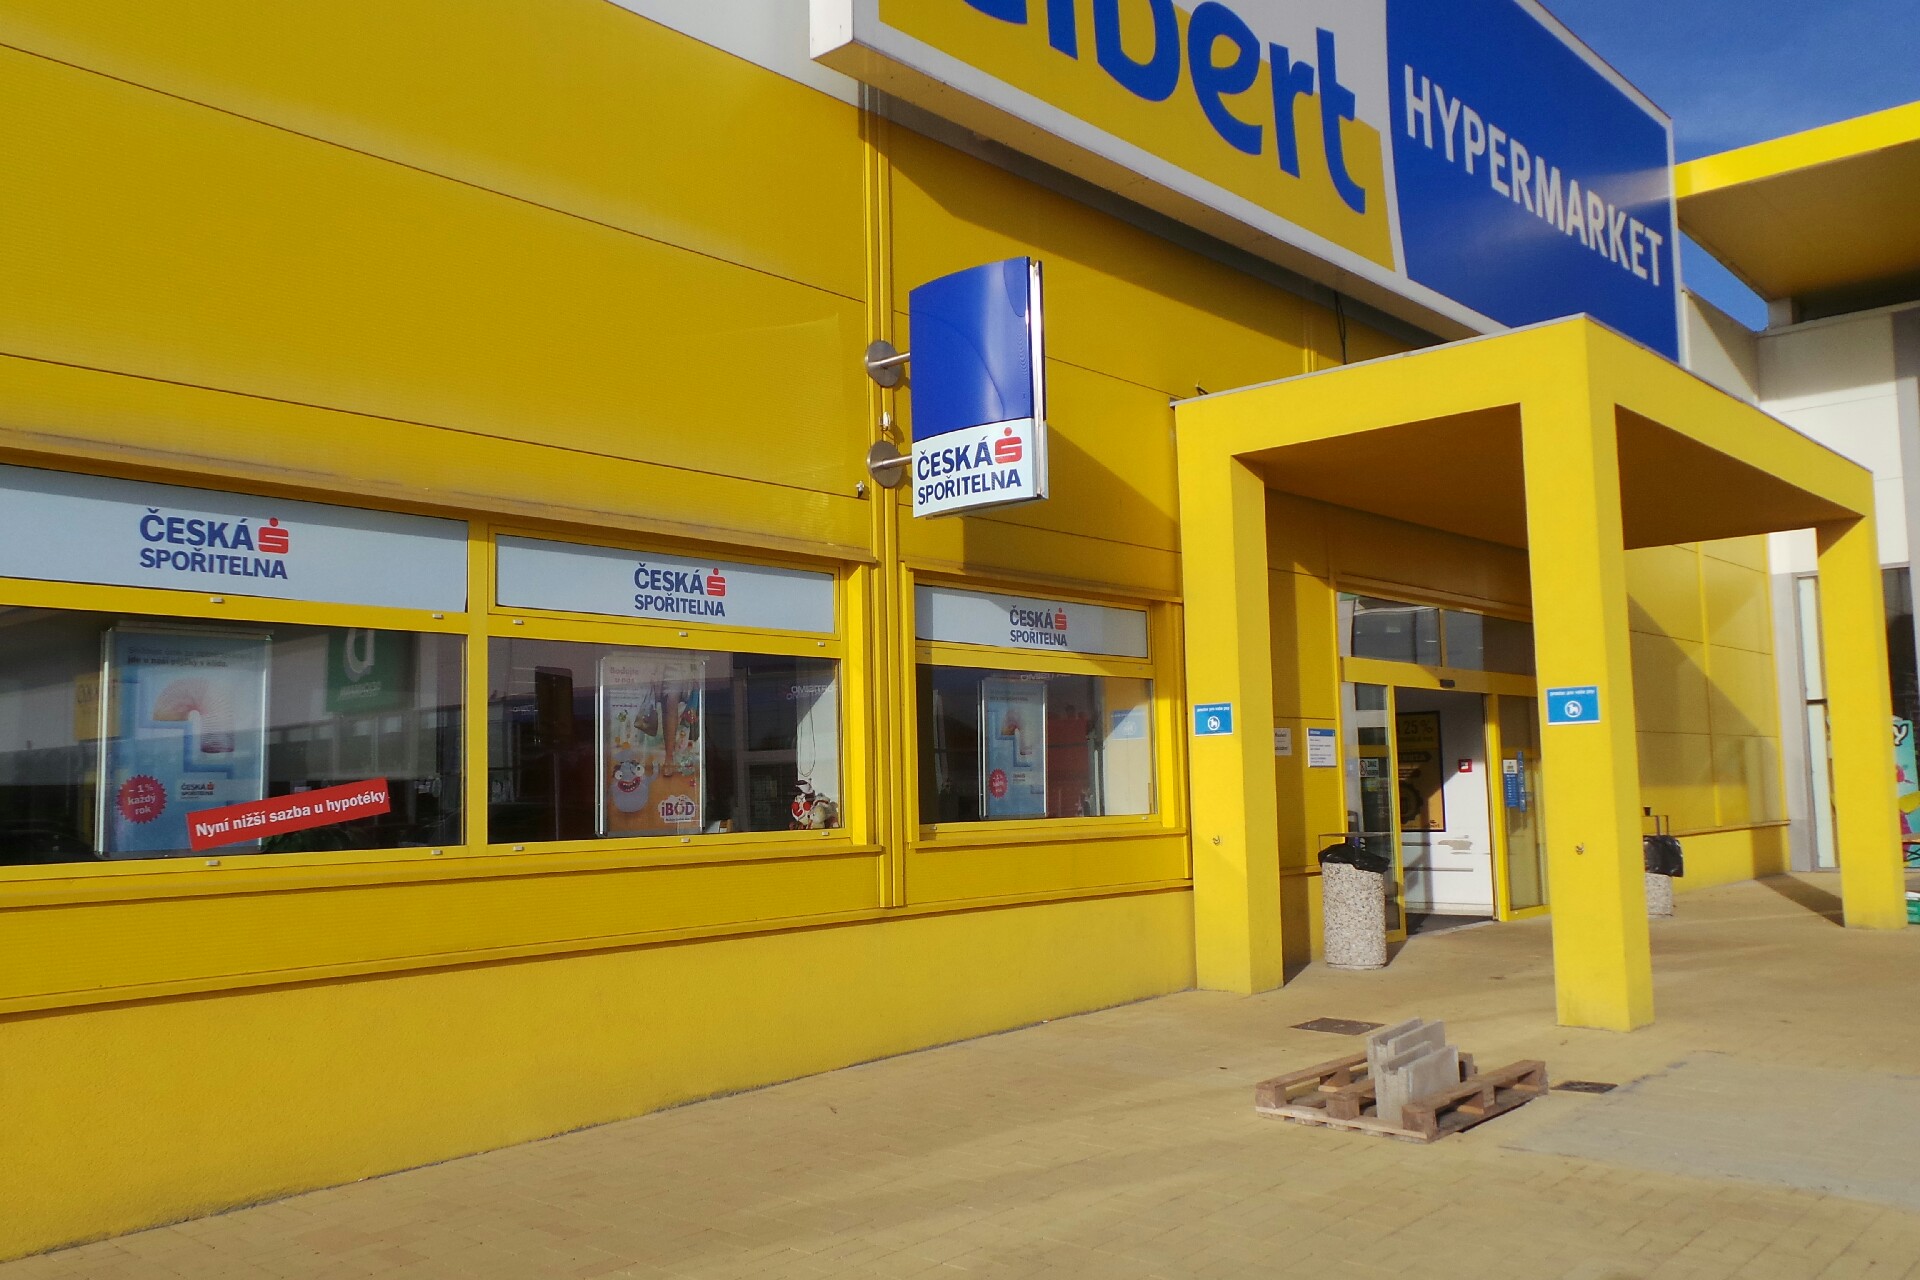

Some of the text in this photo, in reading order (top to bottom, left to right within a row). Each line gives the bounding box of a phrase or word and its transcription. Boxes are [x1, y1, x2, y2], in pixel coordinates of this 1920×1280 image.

[962, 0, 1367, 215] bert
[1404, 63, 1663, 287] HYPERMARKET
[917, 435, 994, 481] ČESKÁ
[918, 468, 1022, 505] SPOŘITELNA
[139, 507, 255, 551] ČESKÁ
[139, 547, 289, 580] SPOŘITELNA
[634, 562, 705, 596] ČESKÁ
[634, 592, 726, 617] SPOŘITELNA
[1010, 604, 1054, 630] ČESKÁ
[1010, 628, 1068, 647] SPOŘITELNA
[135, 806, 151, 815] rok
[195, 790, 386, 838] Nyní nižší sazba u hypotéky
